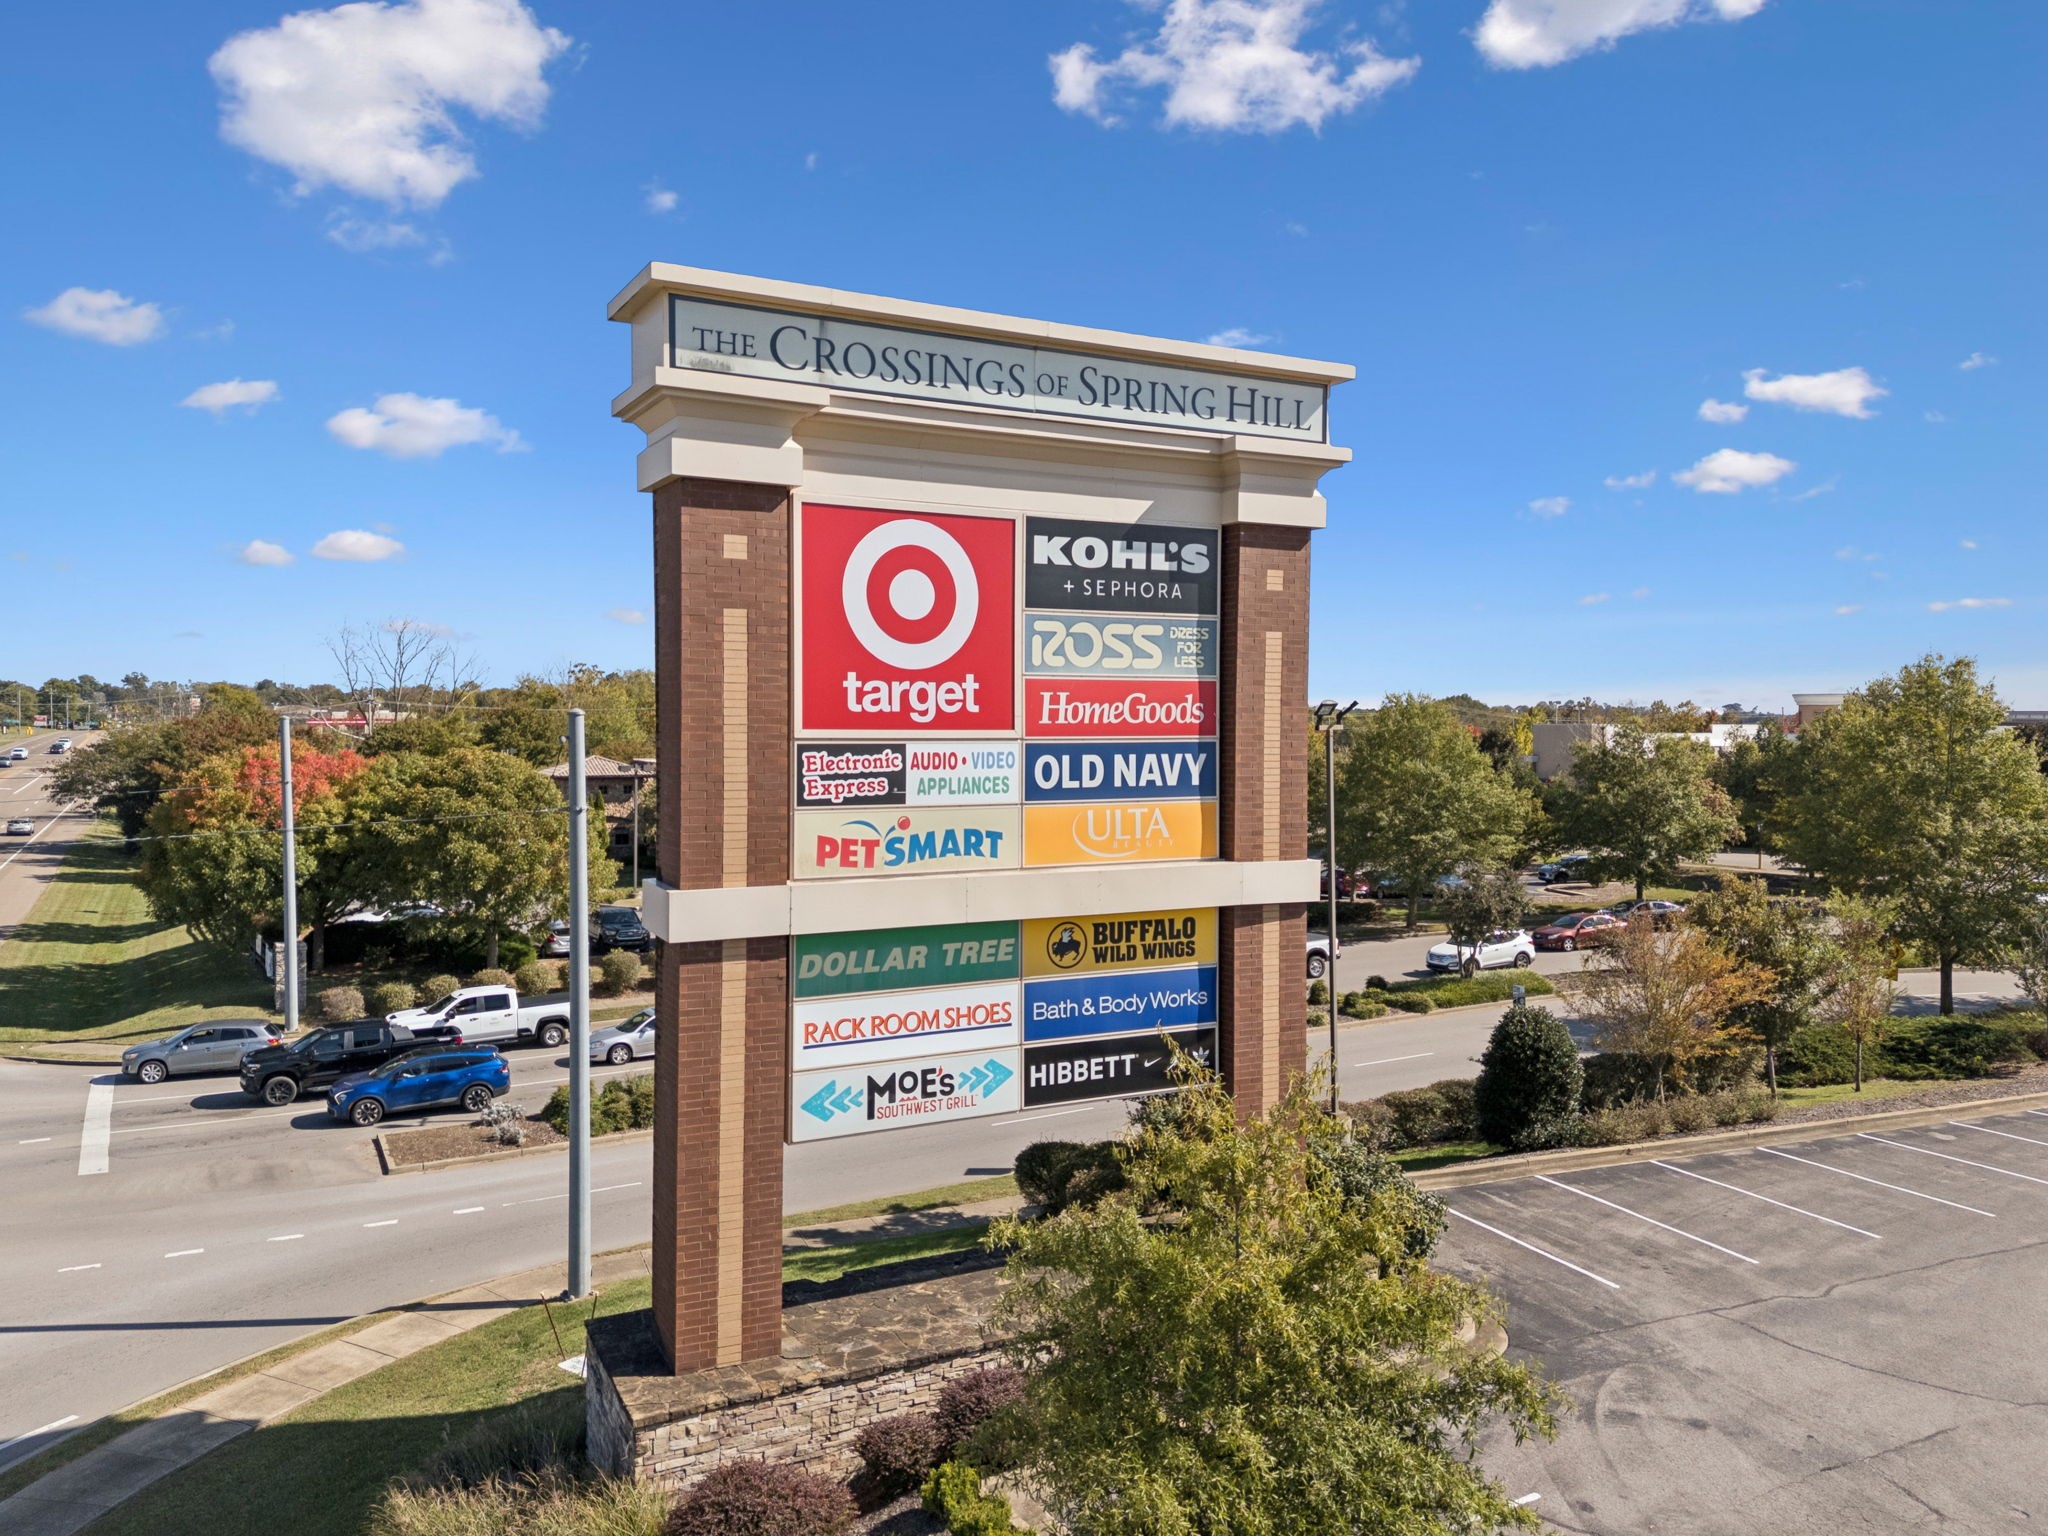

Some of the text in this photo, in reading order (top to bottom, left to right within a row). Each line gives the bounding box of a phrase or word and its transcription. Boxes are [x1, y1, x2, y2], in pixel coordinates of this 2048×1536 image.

[691, 325, 1312, 432] THE CROSSINGS OF SPRING HILL
[1033, 534, 1210, 574] KOHL'S
[1083, 578, 1182, 600] SEPHORA
[1032, 620, 1164, 669] ROSS
[1169, 626, 1210, 640] DRESS
[1176, 641, 1202, 654] FOR
[1174, 655, 1205, 669] LESS
[842, 671, 980, 723] target
[1038, 691, 1205, 725] HomeGoods
[803, 750, 901, 774] Electronic
[910, 751, 1015, 770] AUDIO VIDEO
[1034, 753, 1207, 789] OLD NAVY
[805, 777, 887, 801] Express
[917, 775, 1010, 796] APPLIANCES
[1087, 807, 1170, 841] ULTA
[1092, 916, 1196, 946] BUFFALO
[798, 938, 1015, 979] DOLLAR TREE
[1092, 940, 1196, 964] WILD WINGS
[1033, 989, 1208, 1021] Bath & Body Works
[803, 1001, 1012, 1045] RACK ROOM SHOES
[1030, 1053, 1136, 1088] HIBBETT
[876, 1094, 977, 1120] SOUTHWEST GRILL
